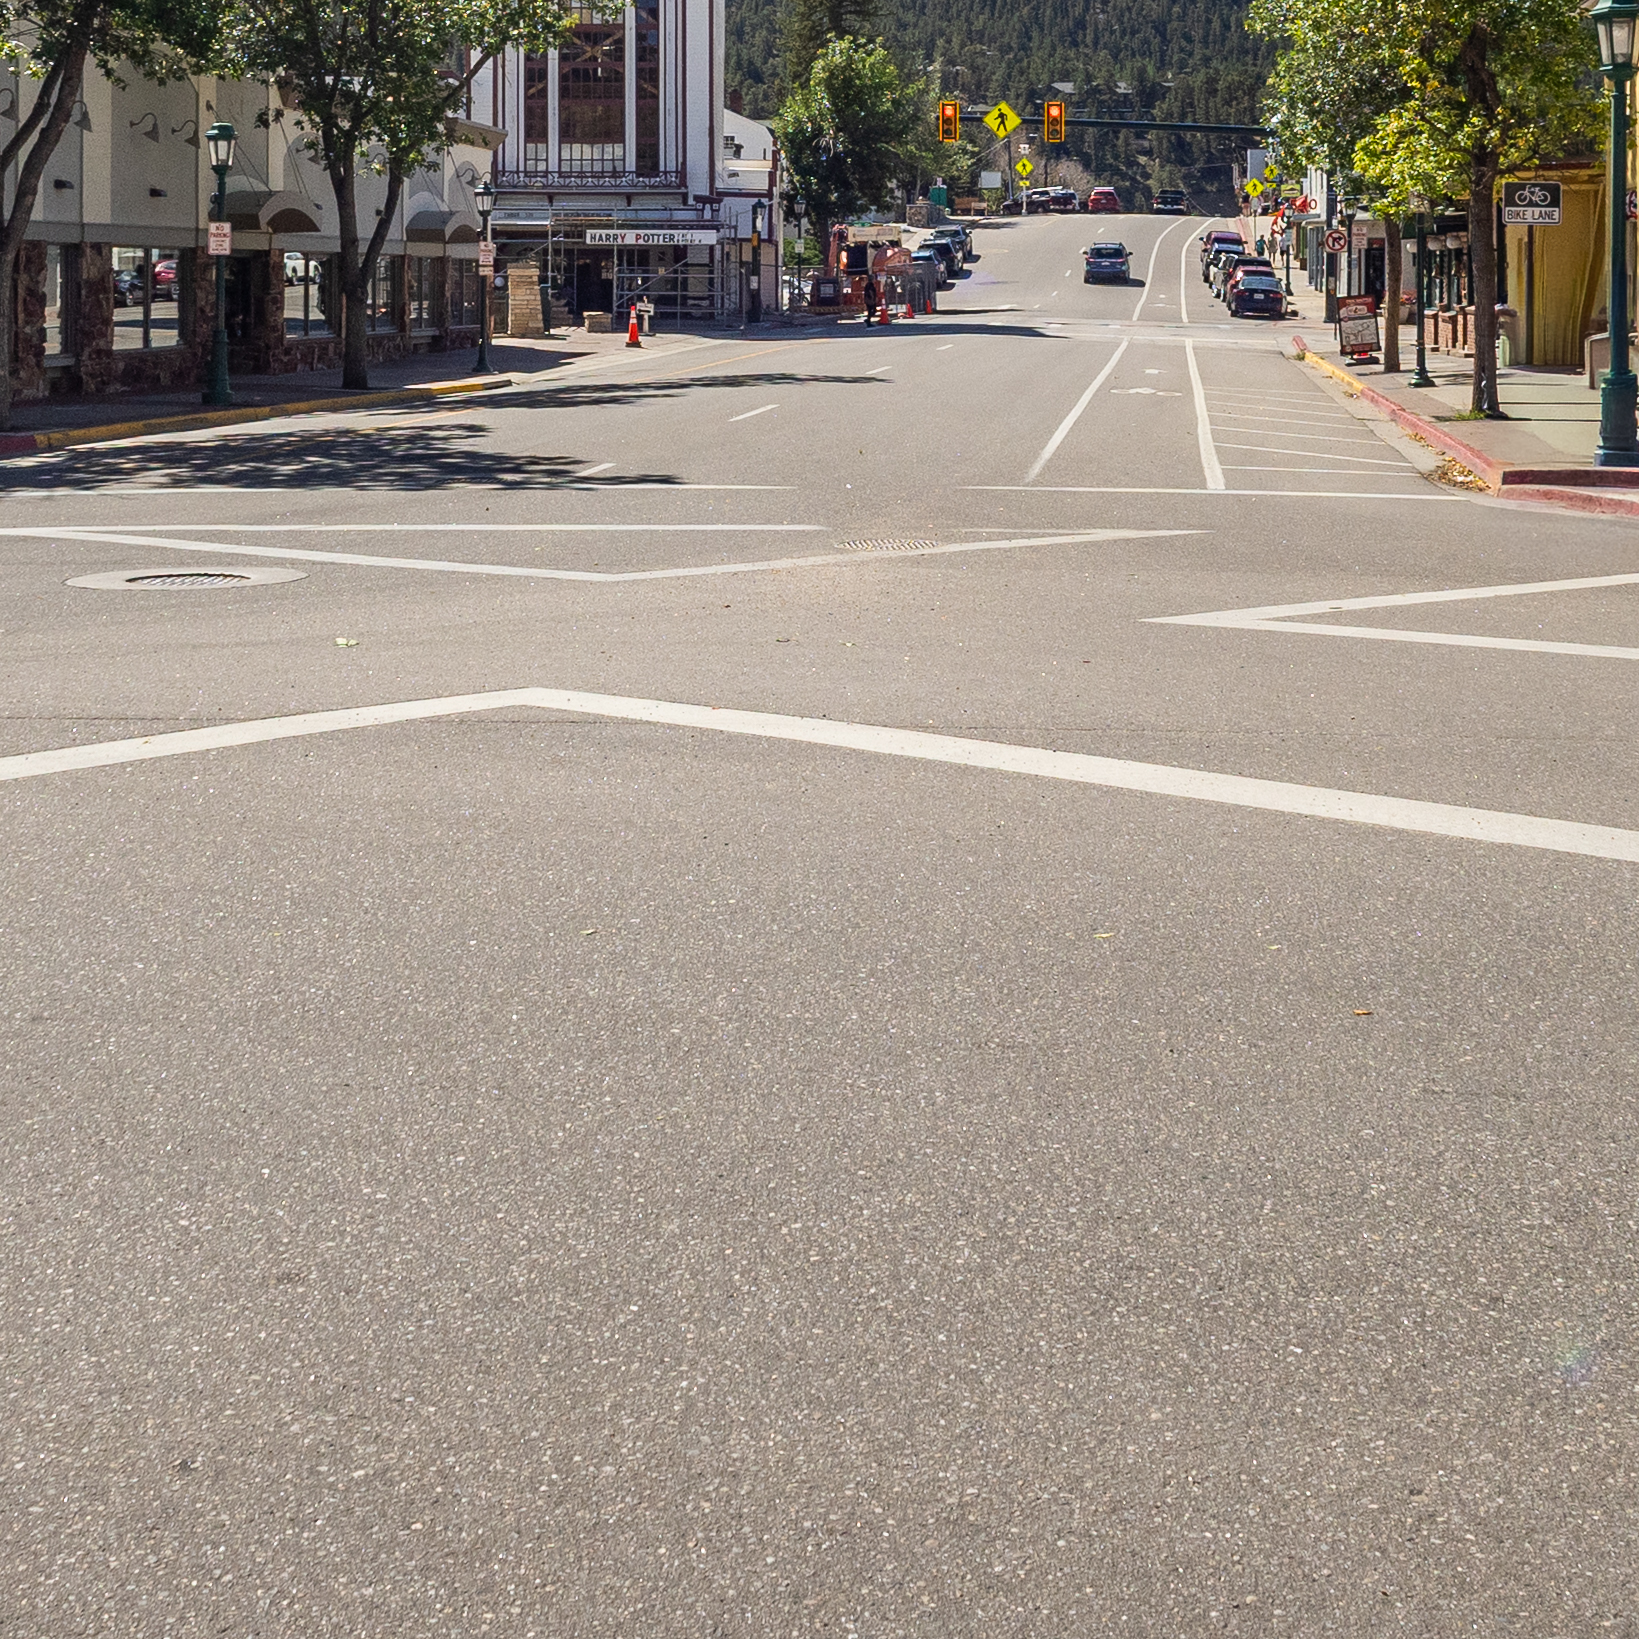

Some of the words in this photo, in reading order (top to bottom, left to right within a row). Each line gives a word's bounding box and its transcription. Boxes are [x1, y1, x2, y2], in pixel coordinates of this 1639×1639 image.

[1507, 209, 1528, 220] BIKE
[1532, 209, 1557, 221] LANE
[590, 233, 626, 244] HARRY
[636, 233, 676, 244] POTTER
